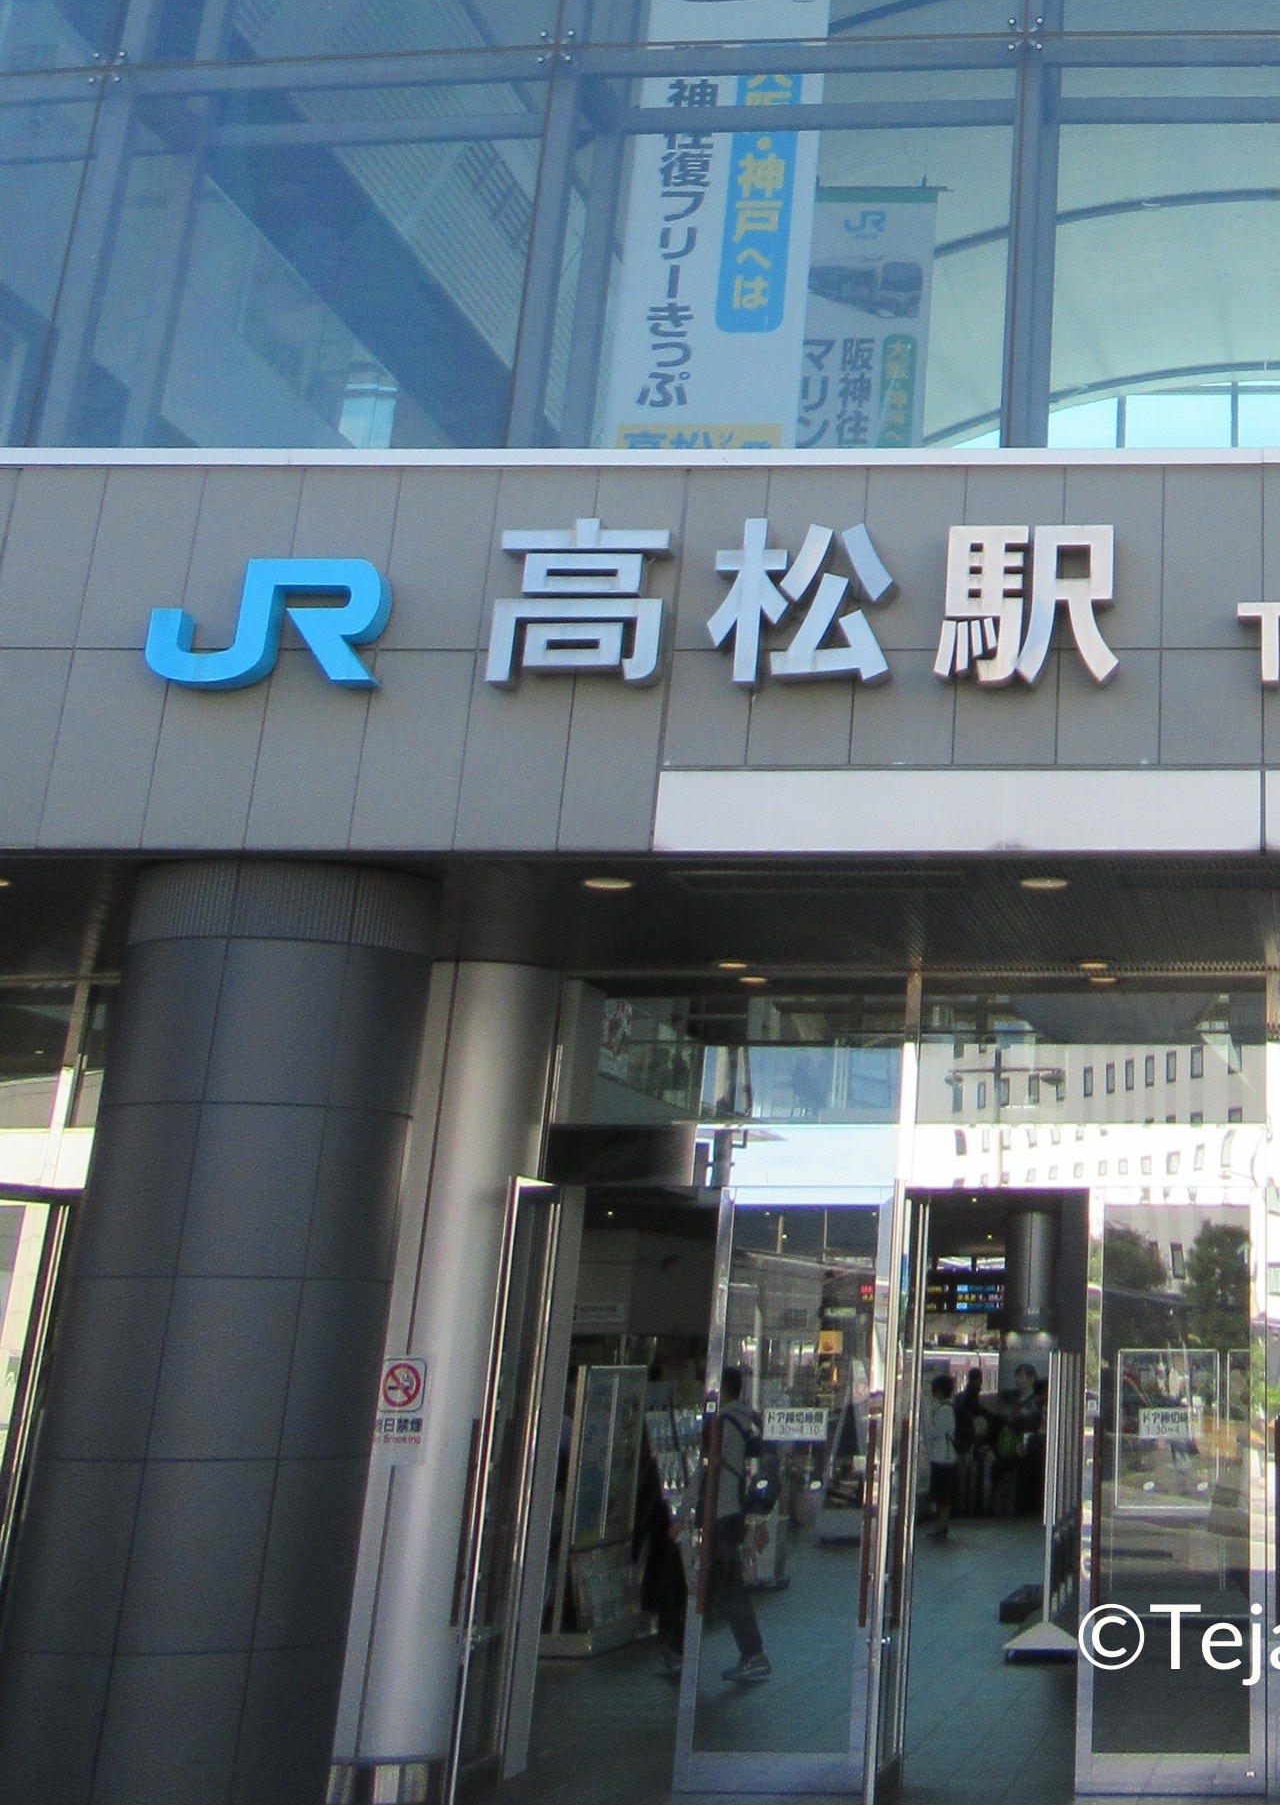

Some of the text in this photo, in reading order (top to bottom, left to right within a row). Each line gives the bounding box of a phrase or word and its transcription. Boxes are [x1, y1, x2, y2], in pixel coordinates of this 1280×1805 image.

[844, 210, 887, 233] JR
[144, 517, 1121, 689] JR 高松駅
